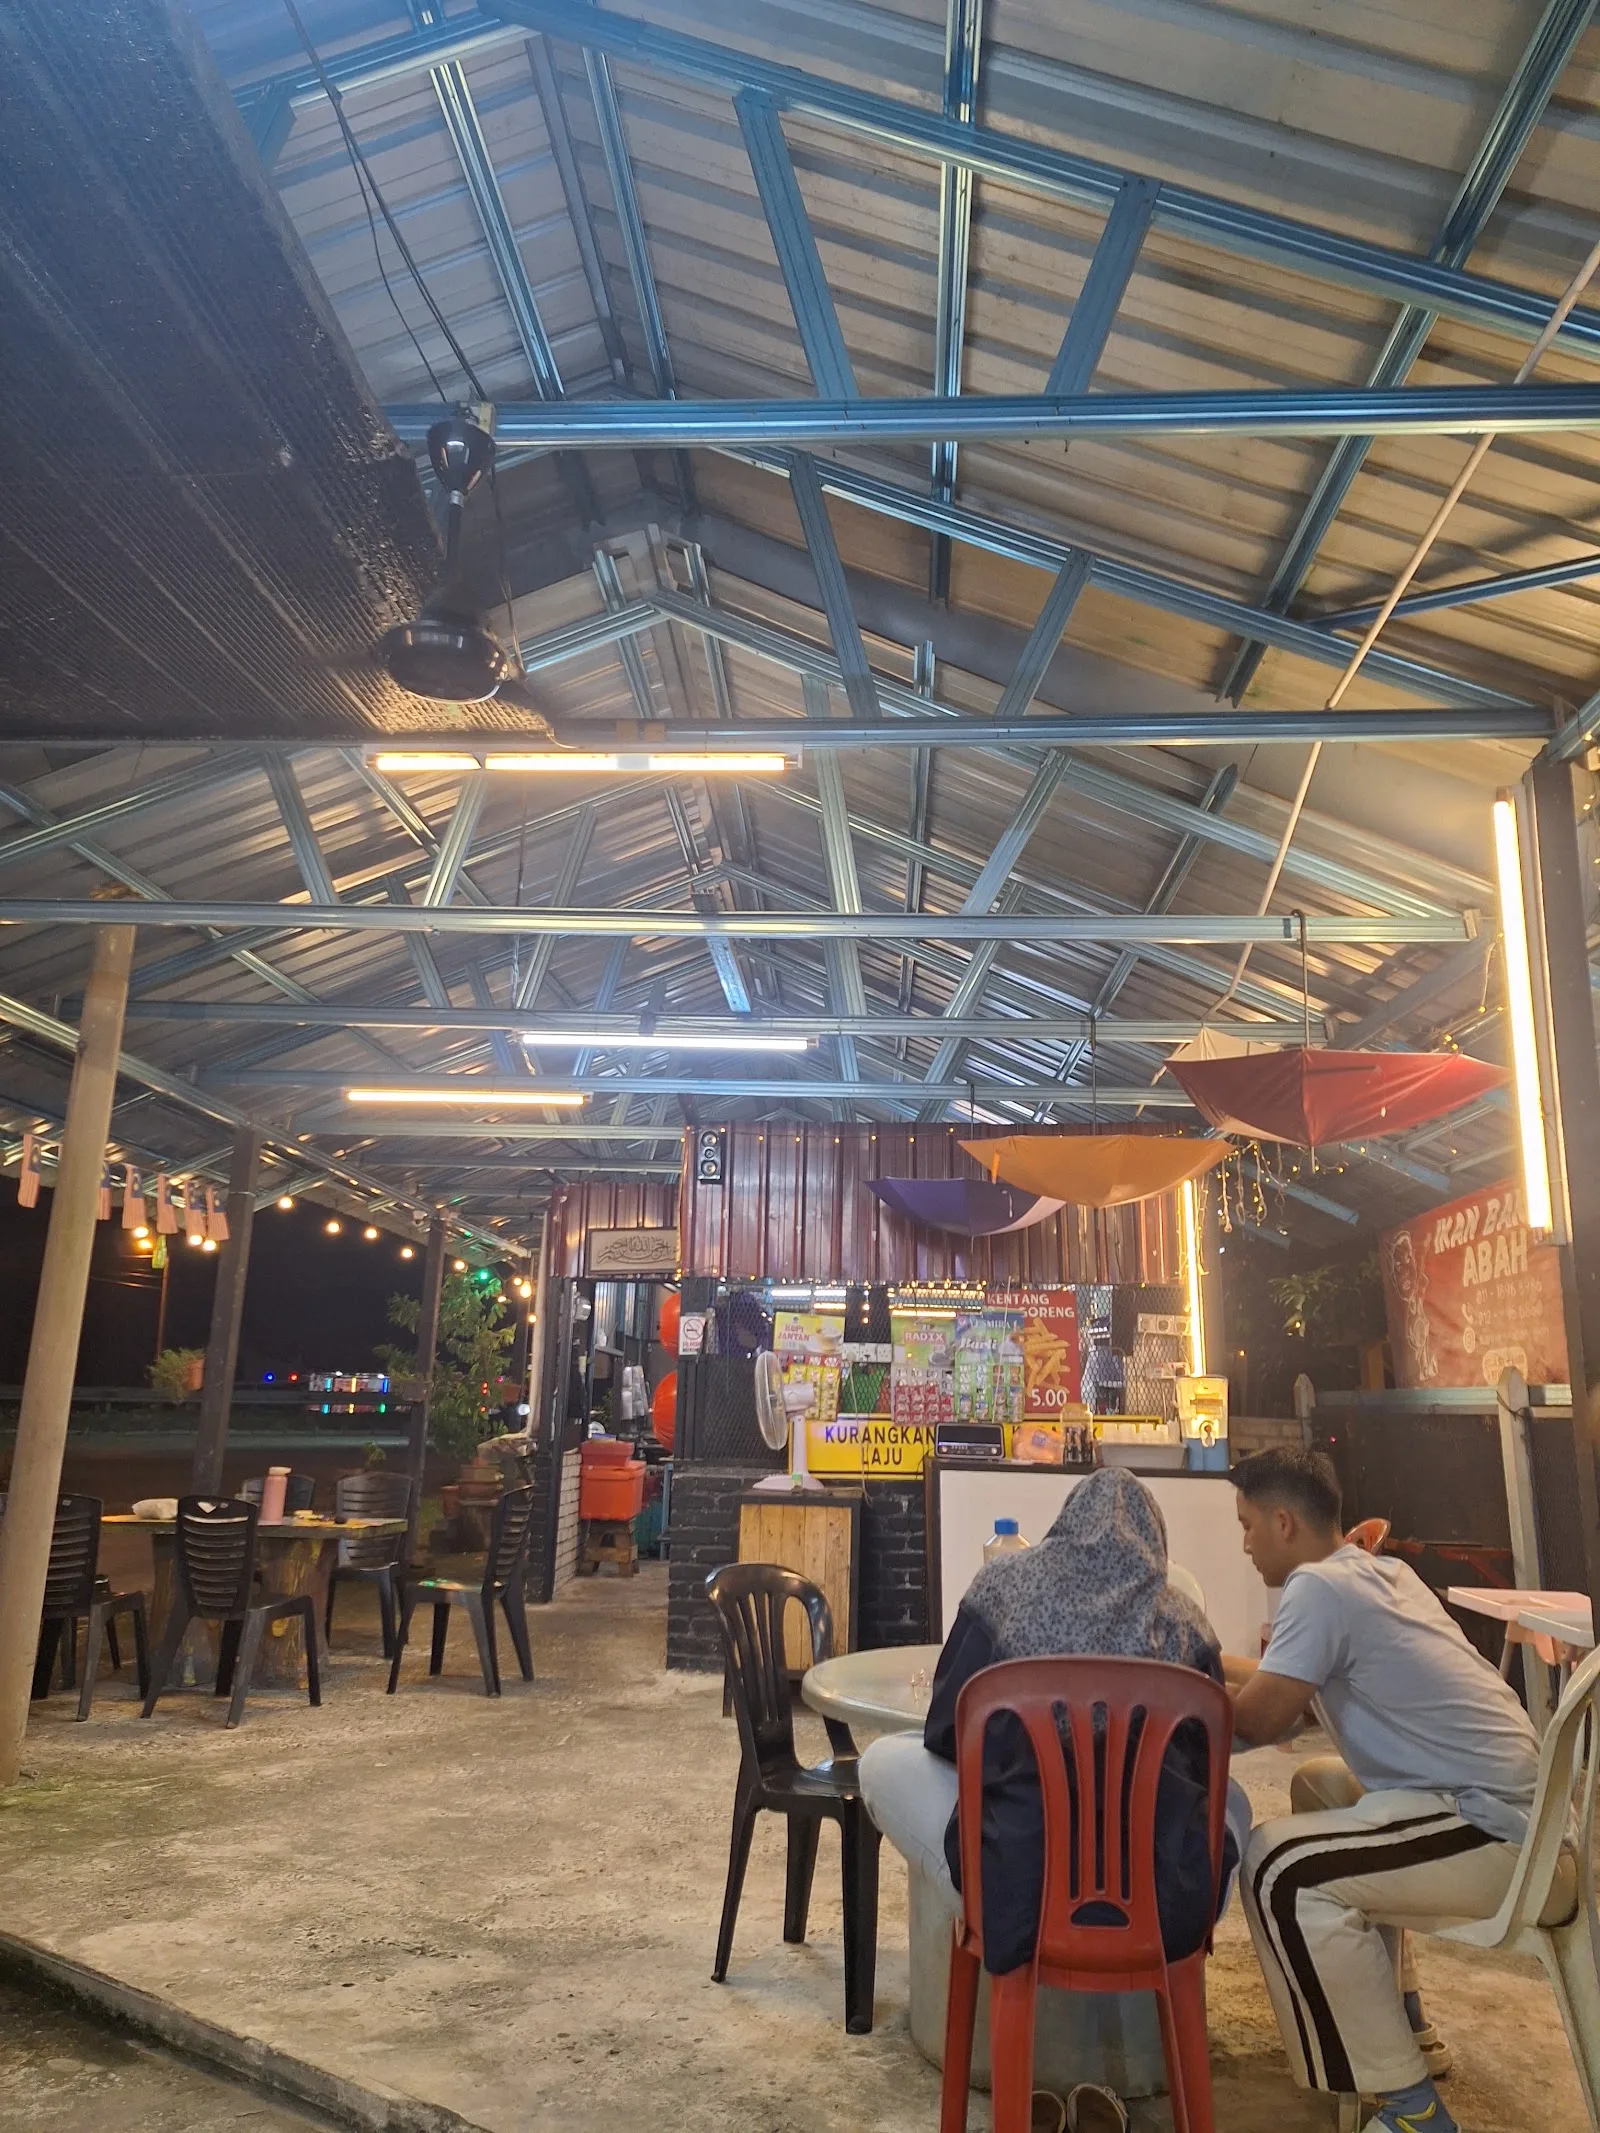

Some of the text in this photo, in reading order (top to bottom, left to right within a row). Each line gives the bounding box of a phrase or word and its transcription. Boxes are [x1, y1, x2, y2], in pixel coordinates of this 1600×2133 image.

[1435, 1189, 1526, 1254] IKAN BAK
[1463, 1228, 1527, 1287] ABAH
[987, 1293, 1049, 1305] KENTANG
[777, 1332, 810, 1341] JANTAN
[784, 1324, 804, 1333] KOPI
[904, 1331, 944, 1341] RADIX
[1031, 1388, 1068, 1407] 5.00
[825, 1426, 935, 1444] KURANGKAN
[862, 1447, 903, 1466] LAJU
